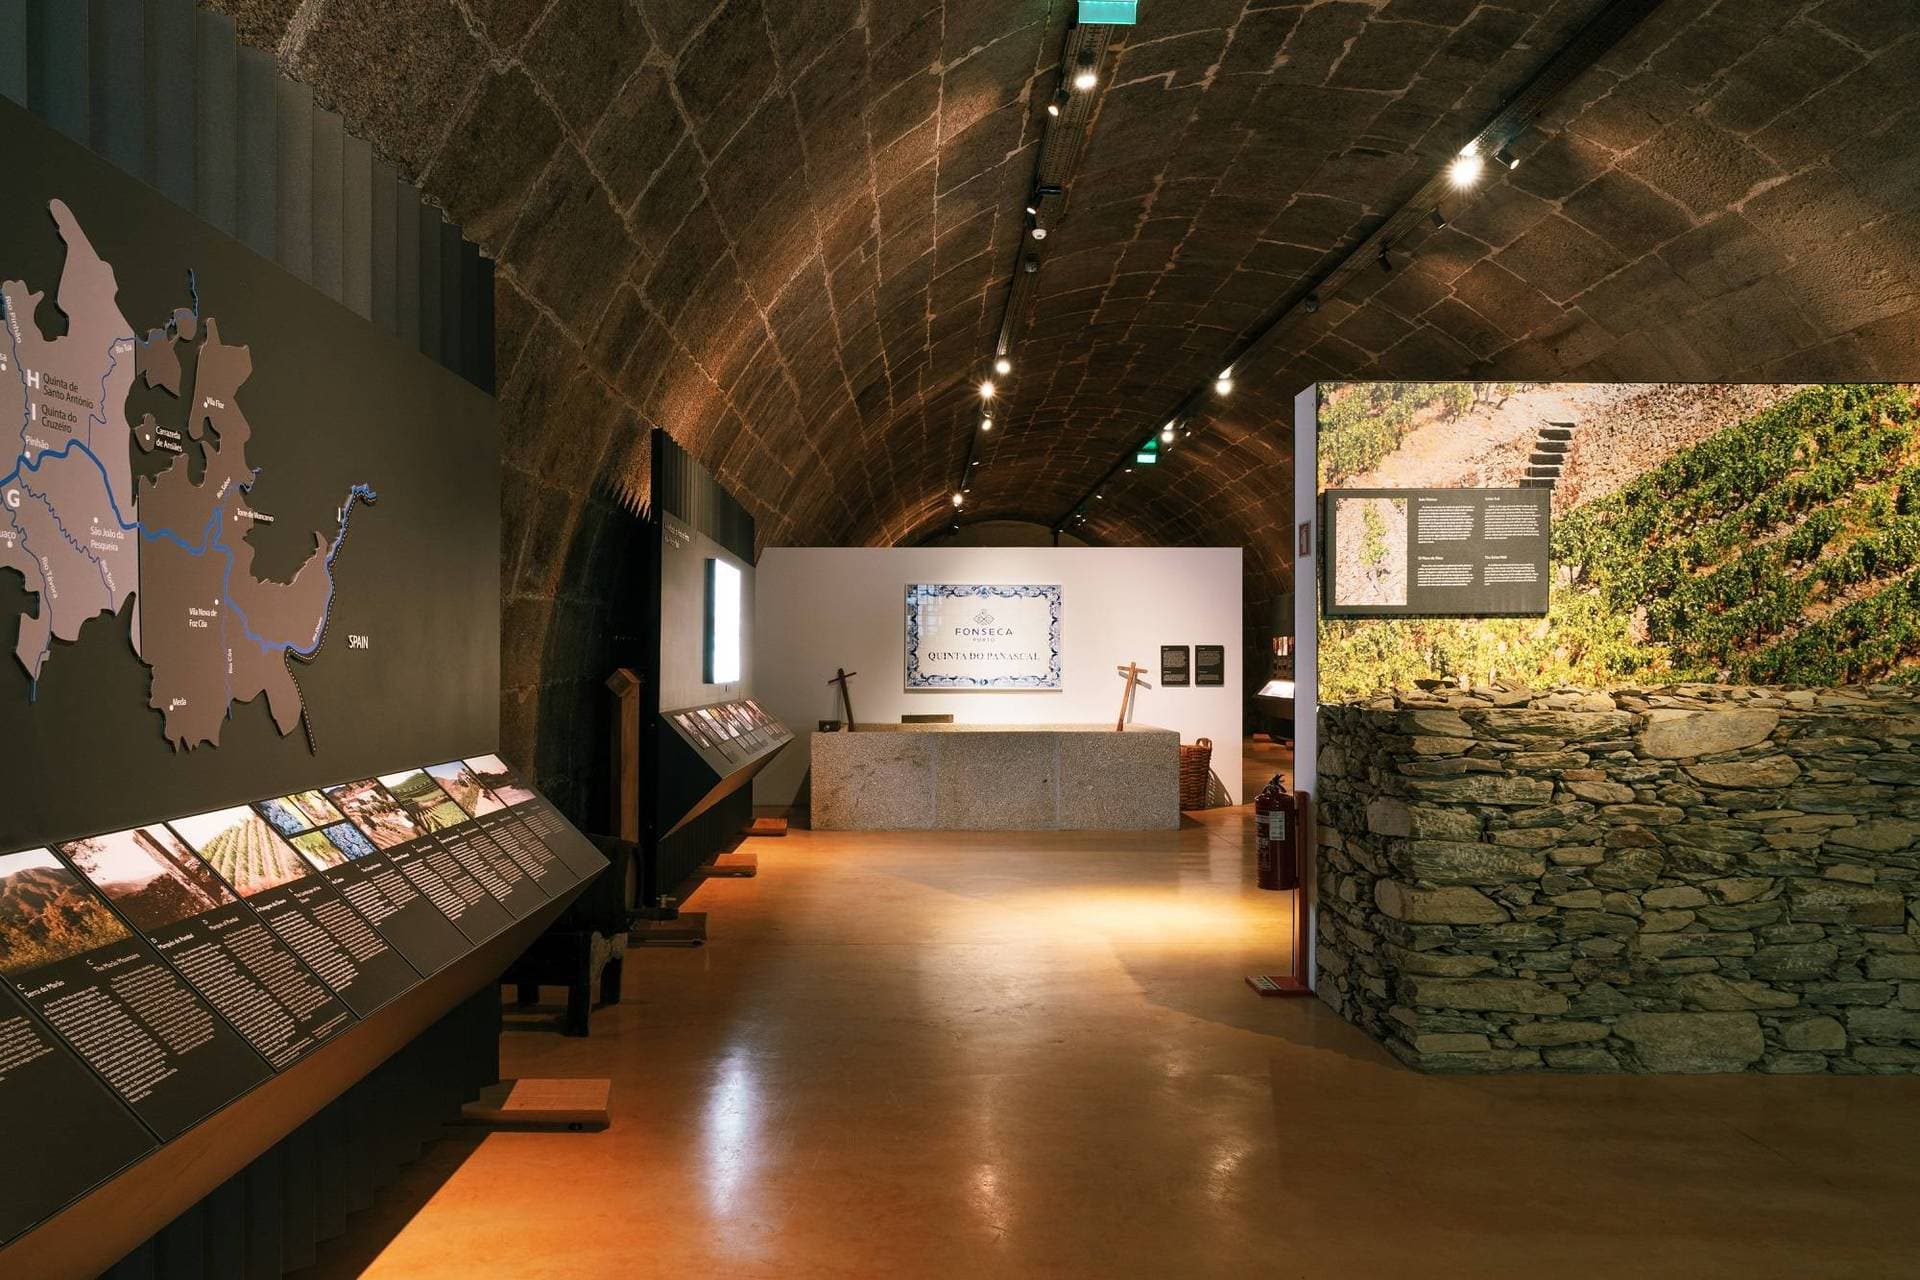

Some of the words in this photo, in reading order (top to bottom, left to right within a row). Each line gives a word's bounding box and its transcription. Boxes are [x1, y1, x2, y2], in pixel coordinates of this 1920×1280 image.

[26, 368, 40, 390] H
[43, 372, 68, 390] Quinta
[69, 383, 79, 392] de
[43, 384, 65, 400] Santo
[31, 403, 36, 421] I
[41, 403, 67, 420] Quinta
[67, 411, 78, 423] do
[41, 416, 72, 434] Cruzeiro
[25, 435, 50, 449] Pinhão
[7, 489, 20, 508] G
[954, 627, 1013, 636] FONSECA
[348, 634, 369, 649] SPAIN
[928, 652, 967, 661] QUINTA
[969, 652, 984, 660] DO
